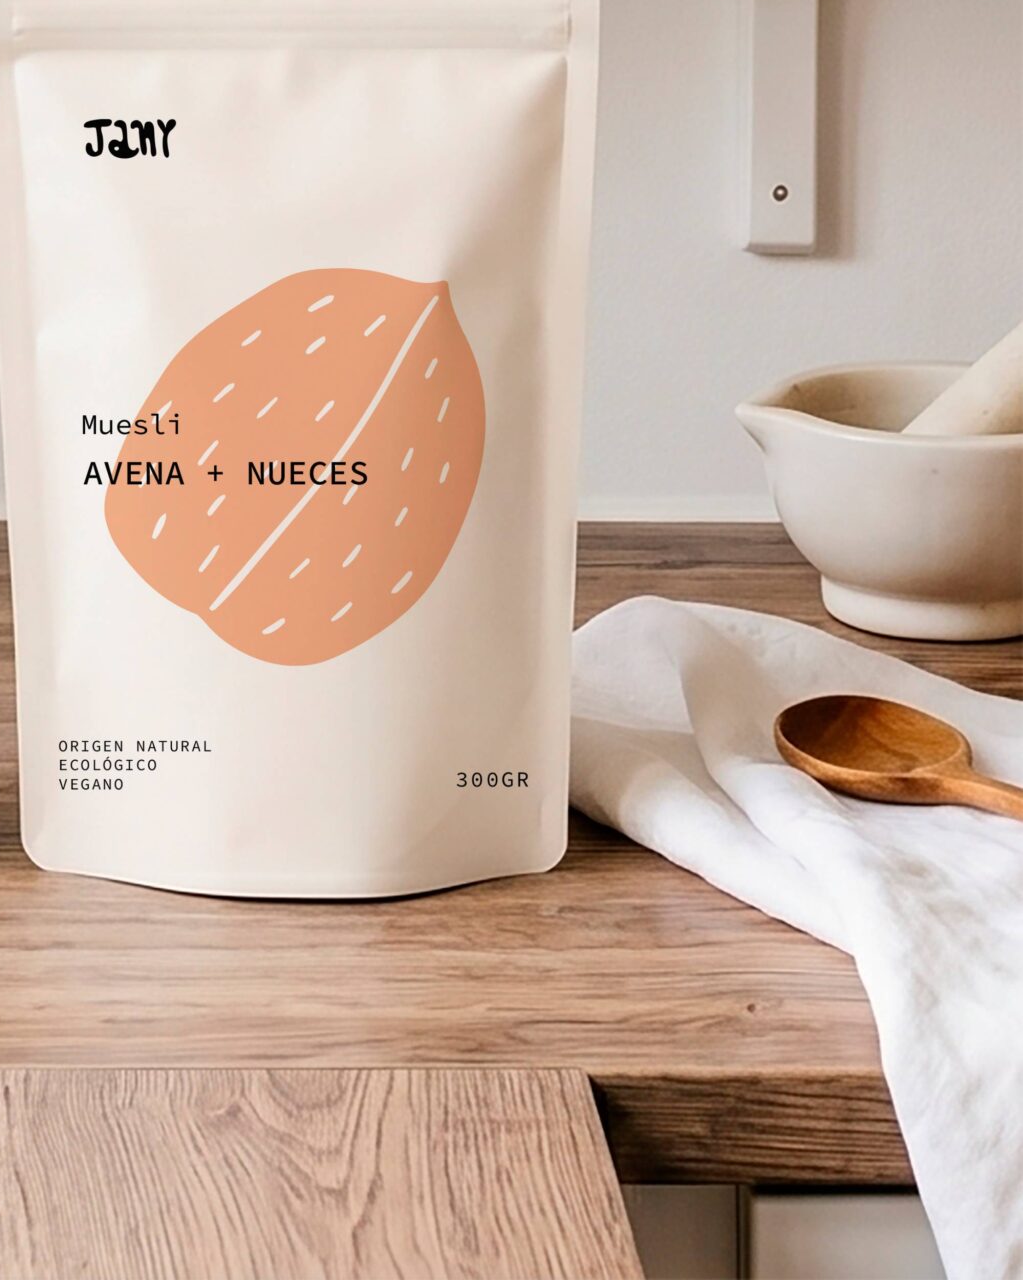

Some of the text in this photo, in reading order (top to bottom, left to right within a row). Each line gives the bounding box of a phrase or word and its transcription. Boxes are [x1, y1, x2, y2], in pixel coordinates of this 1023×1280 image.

[81, 413, 180, 435] Muesli
[83, 461, 369, 486] AVENA + NUECES
[58, 740, 212, 753] ORIGEN NATURAL
[59, 756, 158, 771] ECOLÓGICO
[58, 778, 125, 791] VEGANO
[456, 771, 530, 788] 300GR
